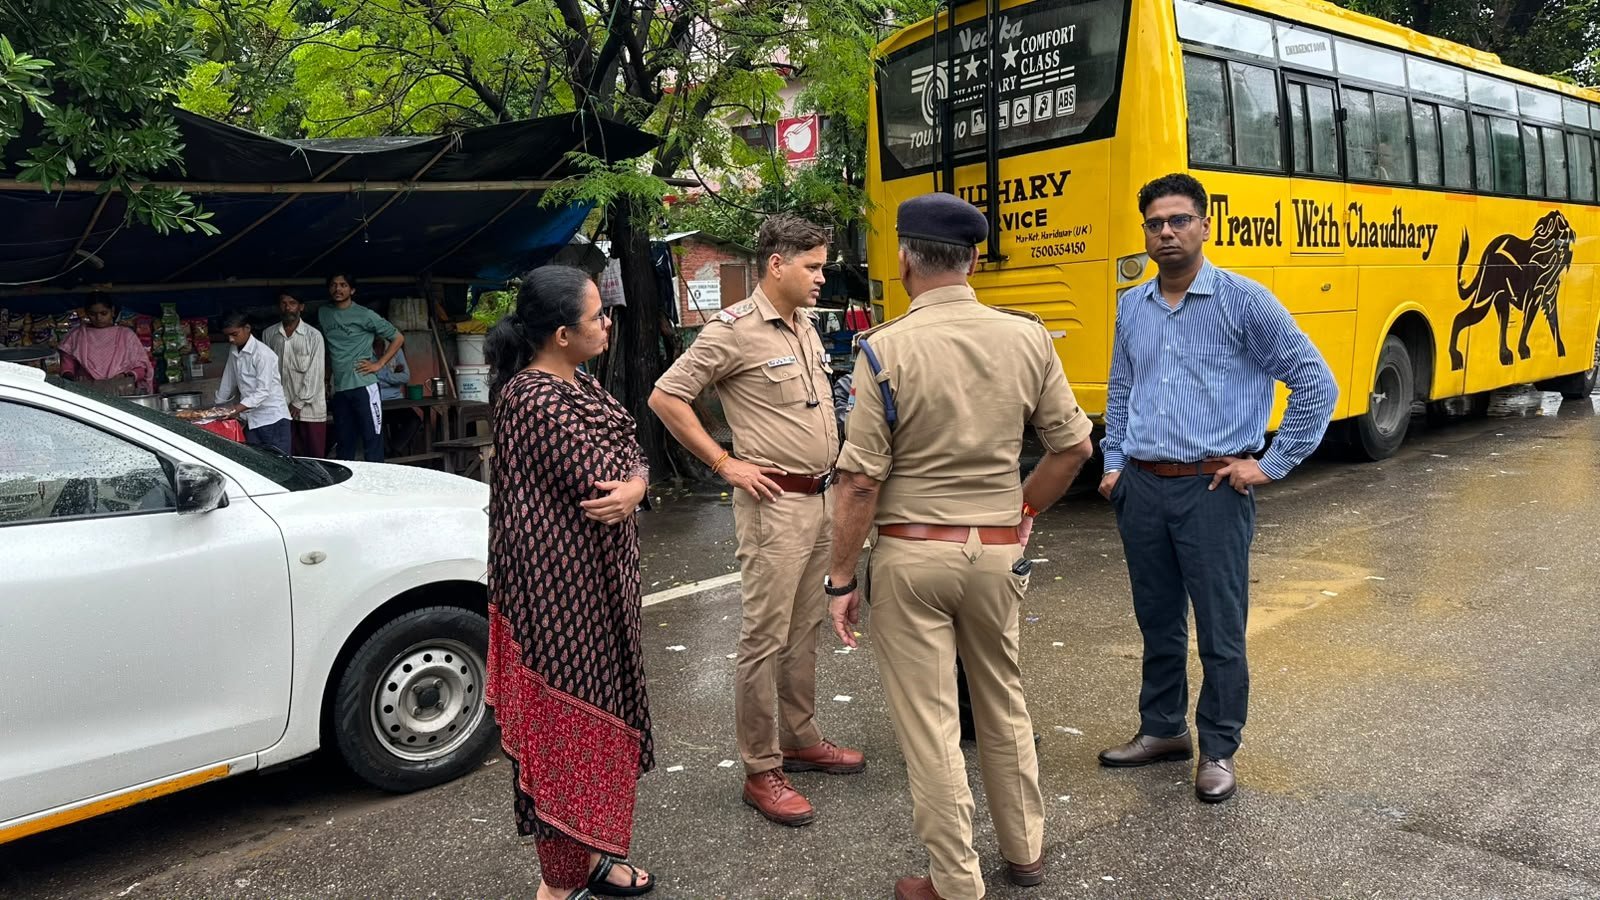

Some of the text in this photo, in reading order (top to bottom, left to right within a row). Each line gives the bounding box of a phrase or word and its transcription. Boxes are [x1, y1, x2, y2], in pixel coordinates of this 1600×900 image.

[959, 16, 1024, 52] Vedka
[1020, 24, 1076, 55] COMFORT
[1020, 49, 1060, 76] CLASS
[1058, 90, 1074, 109] ABS
[958, 170, 1072, 206] UDHARY
[1209, 194, 1438, 261] Travel With Chaudhary
[1030, 241, 1086, 258] 7500354150
